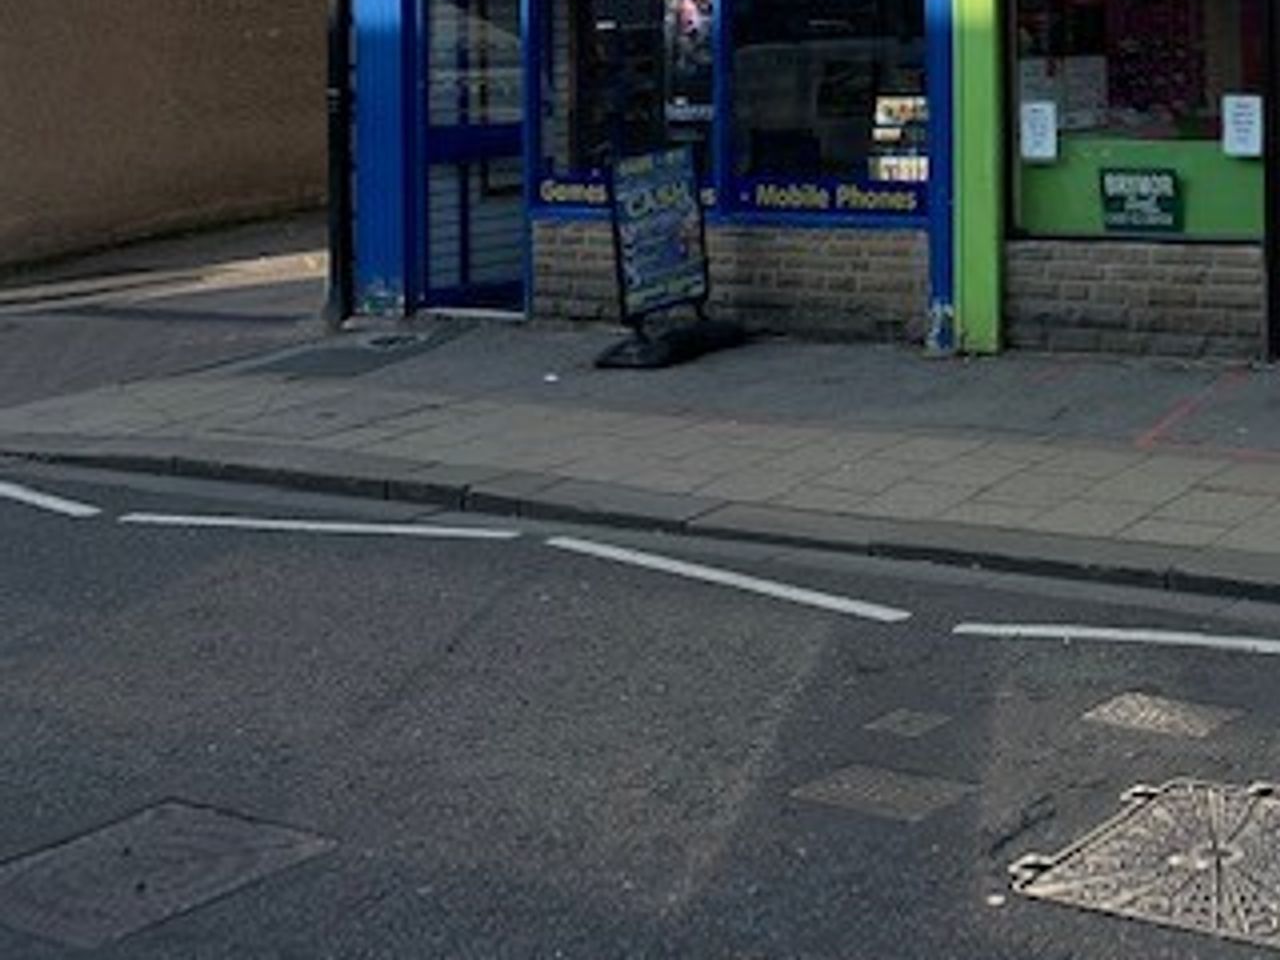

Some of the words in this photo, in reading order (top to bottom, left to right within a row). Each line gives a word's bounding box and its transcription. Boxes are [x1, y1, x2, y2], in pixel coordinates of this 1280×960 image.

[538, 178, 608, 205] Games
[755, 182, 830, 210] Mobile
[834, 183, 919, 212] Phones
